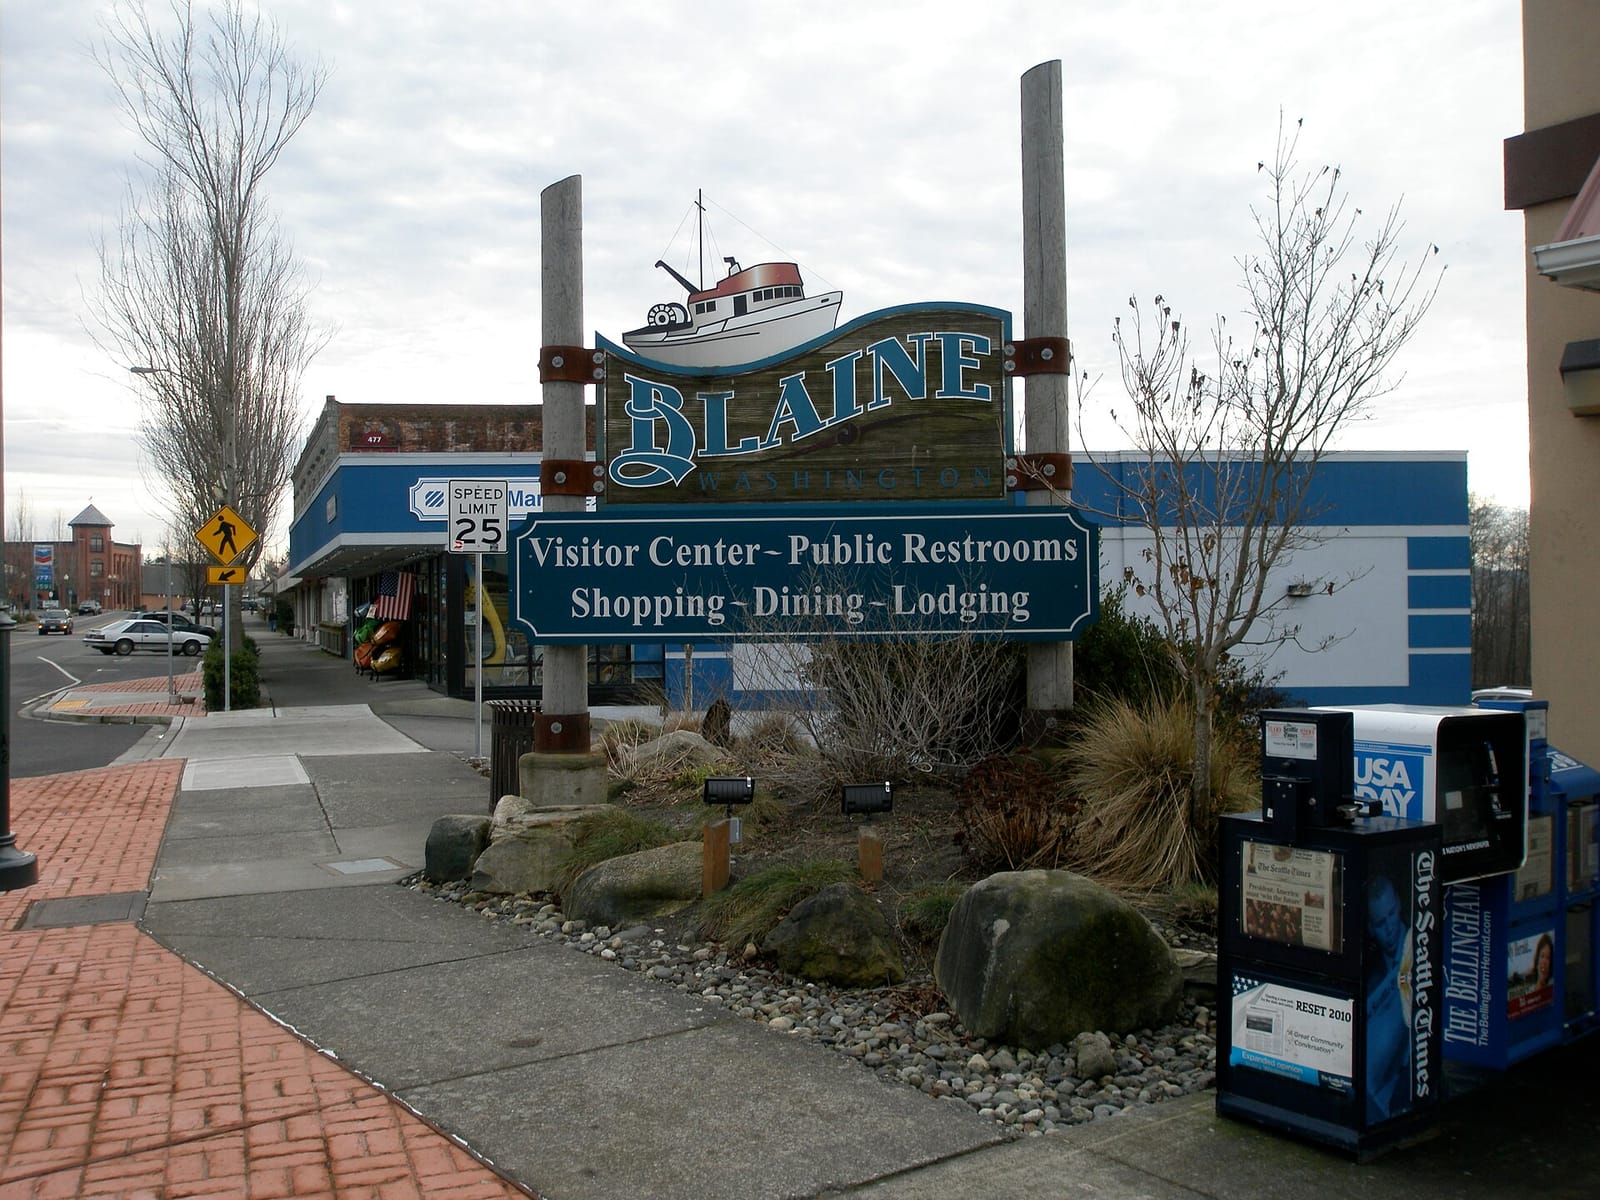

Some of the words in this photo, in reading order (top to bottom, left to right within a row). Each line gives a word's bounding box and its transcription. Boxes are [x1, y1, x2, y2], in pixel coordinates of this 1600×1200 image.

[608, 331, 992, 488] BLAINE
[454, 488, 503, 499] SPEED
[699, 467, 991, 490] WASHINGTON
[459, 503, 497, 515] LIMIT
[456, 518, 502, 544] 25
[528, 536, 639, 567] Visitor
[788, 533, 892, 565] Public
[902, 533, 1078, 564] Restrooms
[571, 587, 725, 626] Shopping
[753, 586, 864, 625] Dining
[892, 583, 1030, 622] Lodging
[1354, 757, 1412, 790] USA
[1354, 785, 1415, 818] DAY
[1415, 850, 1435, 908] The
[1415, 911, 1435, 1007] Seattle
[1445, 884, 1480, 1003] BELLINGHAM
[1296, 1000, 1327, 1017] RESET
[1329, 1008, 1352, 1023] 2010
[1444, 1005, 1478, 1045] THE
[1294, 1031, 1310, 1040] Great
[1310, 1035, 1344, 1049] Community
[1414, 1007, 1433, 1098] Times
[1241, 1050, 1275, 1067] Expanded
[1277, 1062, 1304, 1074] opinion
